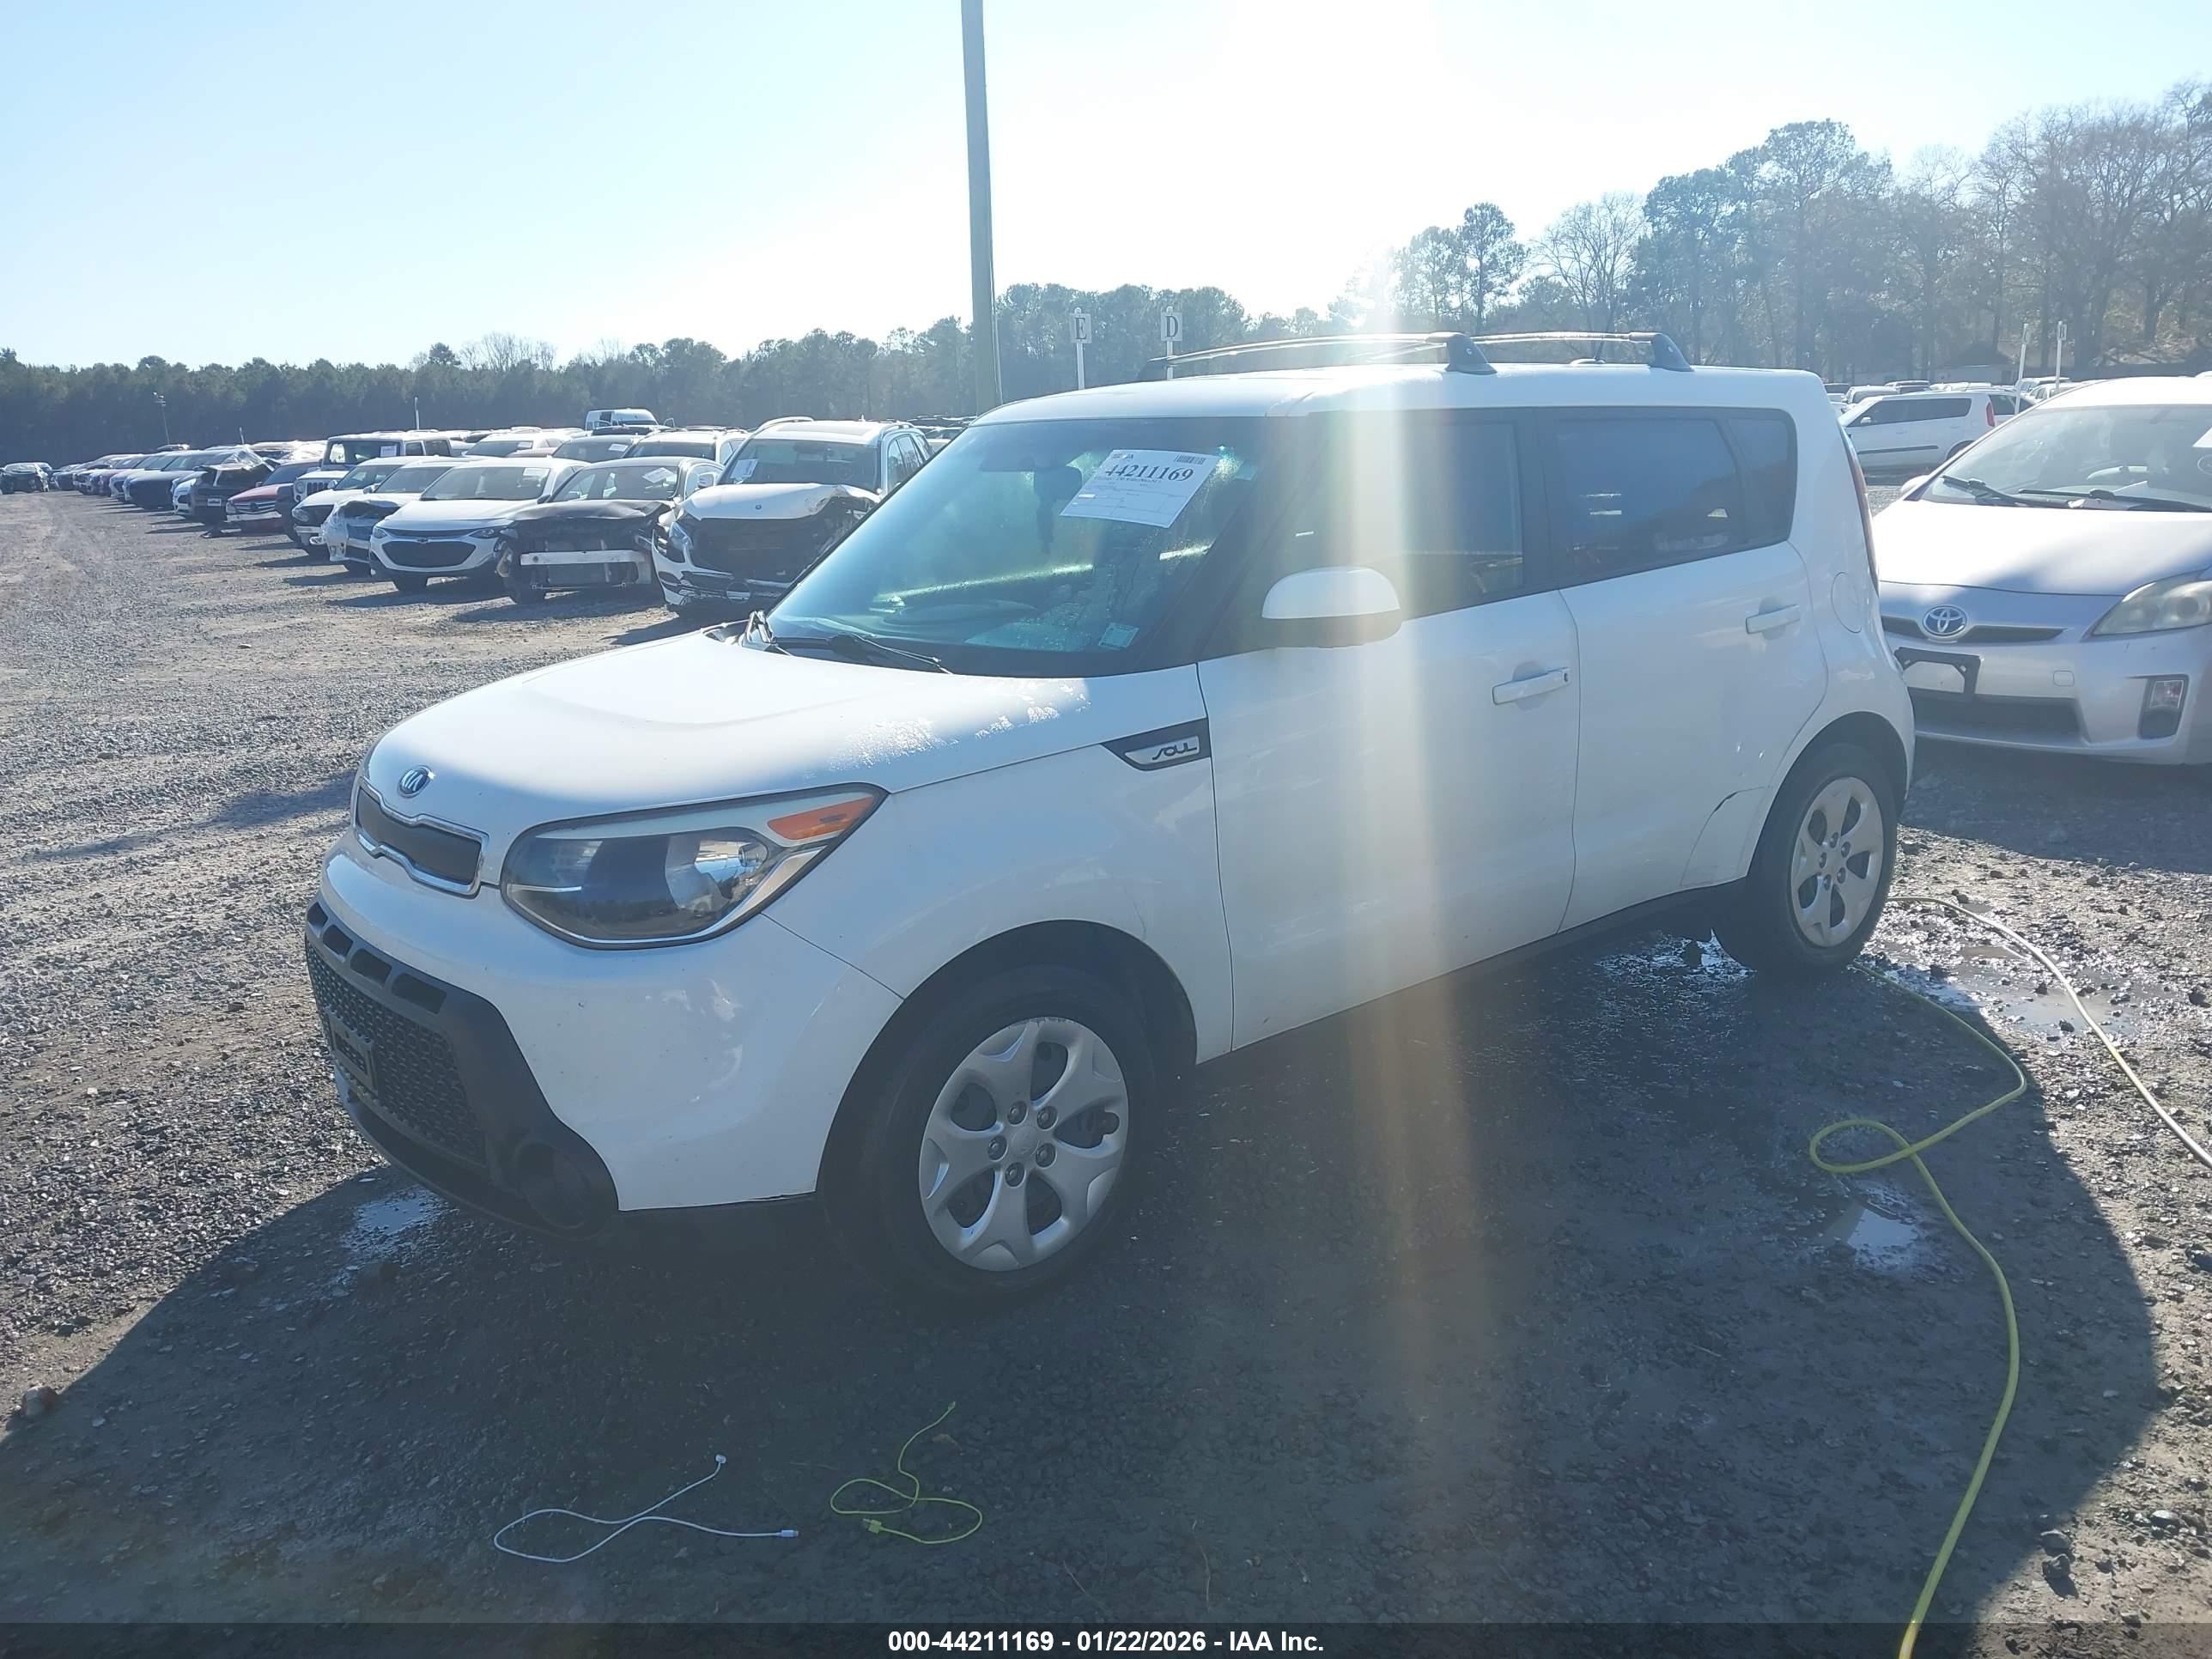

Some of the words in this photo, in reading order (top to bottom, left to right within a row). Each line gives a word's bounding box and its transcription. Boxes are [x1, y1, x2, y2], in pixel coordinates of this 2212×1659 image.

[1075, 317, 1087, 340] E
[1165, 315, 1179, 337] D
[1105, 464, 1194, 482] 44211169
